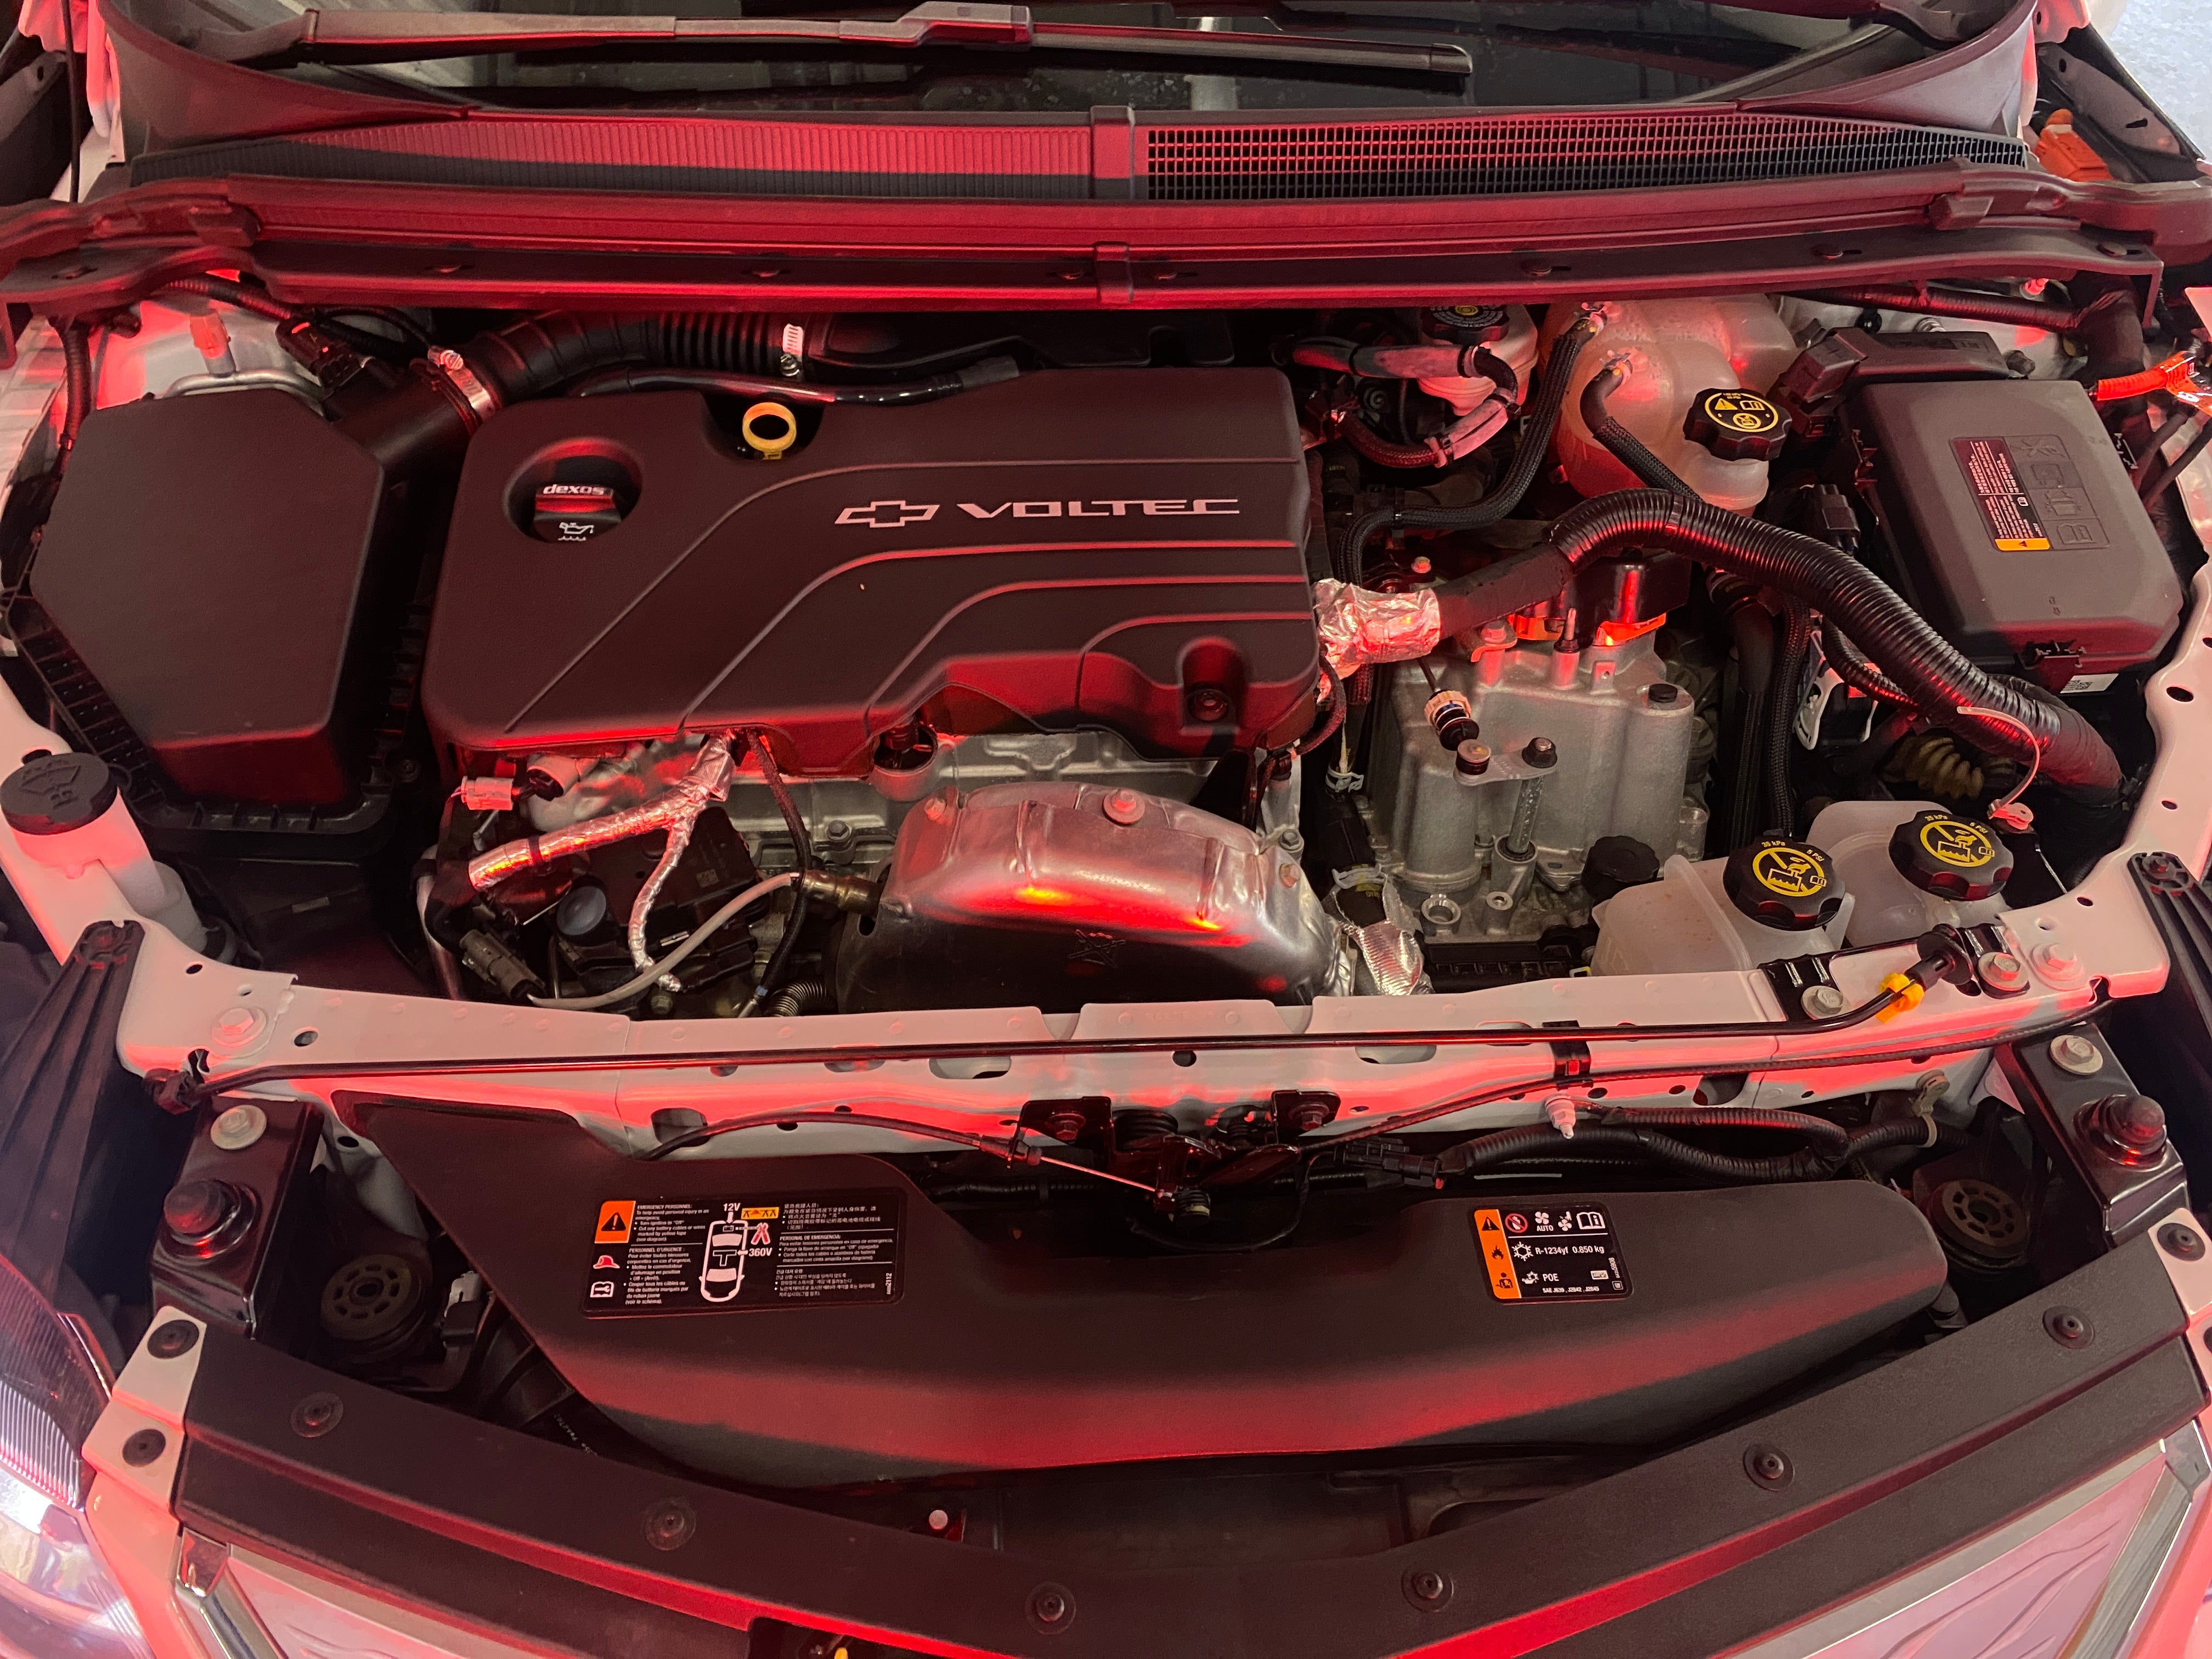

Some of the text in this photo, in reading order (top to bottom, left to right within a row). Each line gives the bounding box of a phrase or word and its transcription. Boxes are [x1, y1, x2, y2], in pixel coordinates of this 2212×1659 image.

[957, 499, 1240, 518] VOLTEC
[1975, 825, 1988, 833] PSI
[1812, 853, 1825, 862] PSI
[724, 1203, 741, 1211] 12V
[749, 1248, 772, 1257] 360V
[1535, 1246, 1568, 1255] R-1234yf
[1594, 1245, 1604, 1254] kg
[1543, 1273, 1559, 1282] POE
